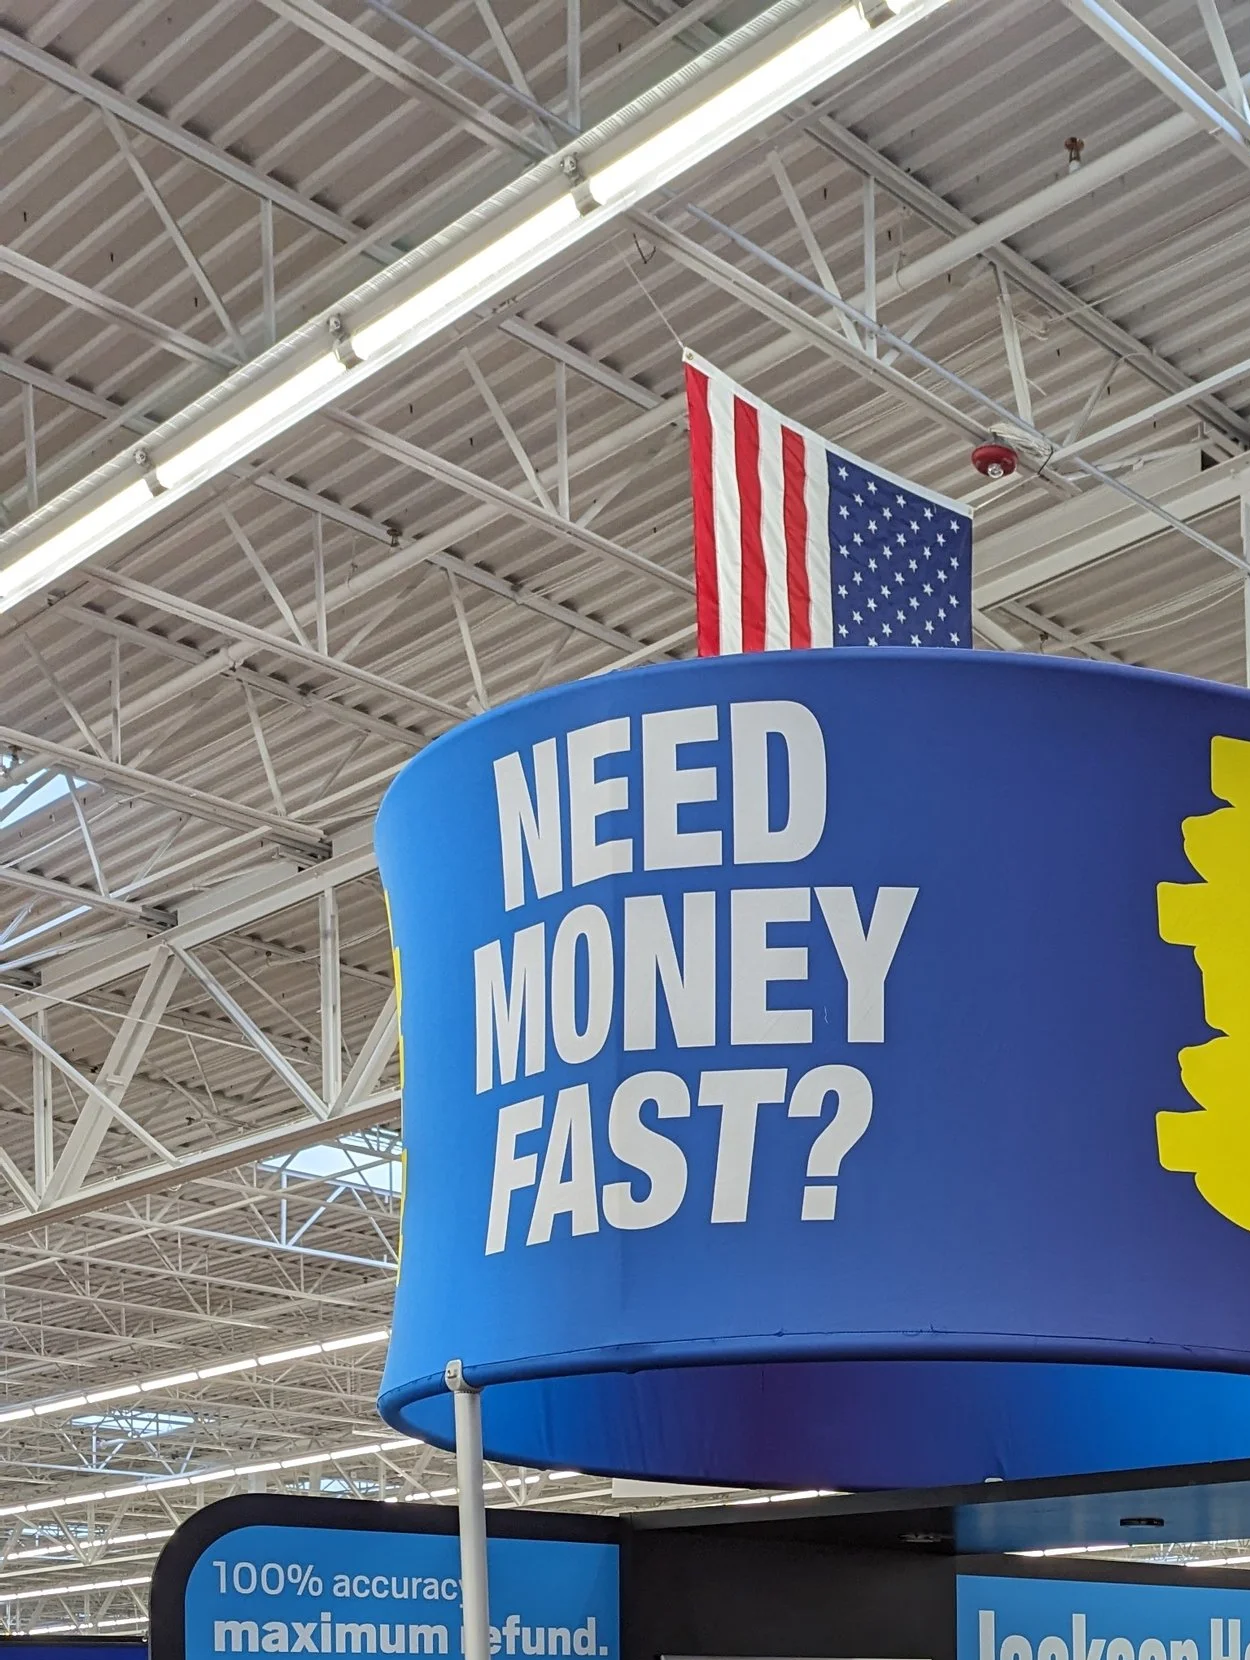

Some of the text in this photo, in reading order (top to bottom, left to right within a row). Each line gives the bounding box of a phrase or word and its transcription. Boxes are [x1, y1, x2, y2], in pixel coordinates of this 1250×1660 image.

[493, 701, 827, 911] NEED
[473, 887, 919, 1095] MONEY
[484, 1064, 873, 1255] FAST?
[212, 1560, 464, 1608] 100% accurac
[214, 1612, 608, 1656] maximum efund.
